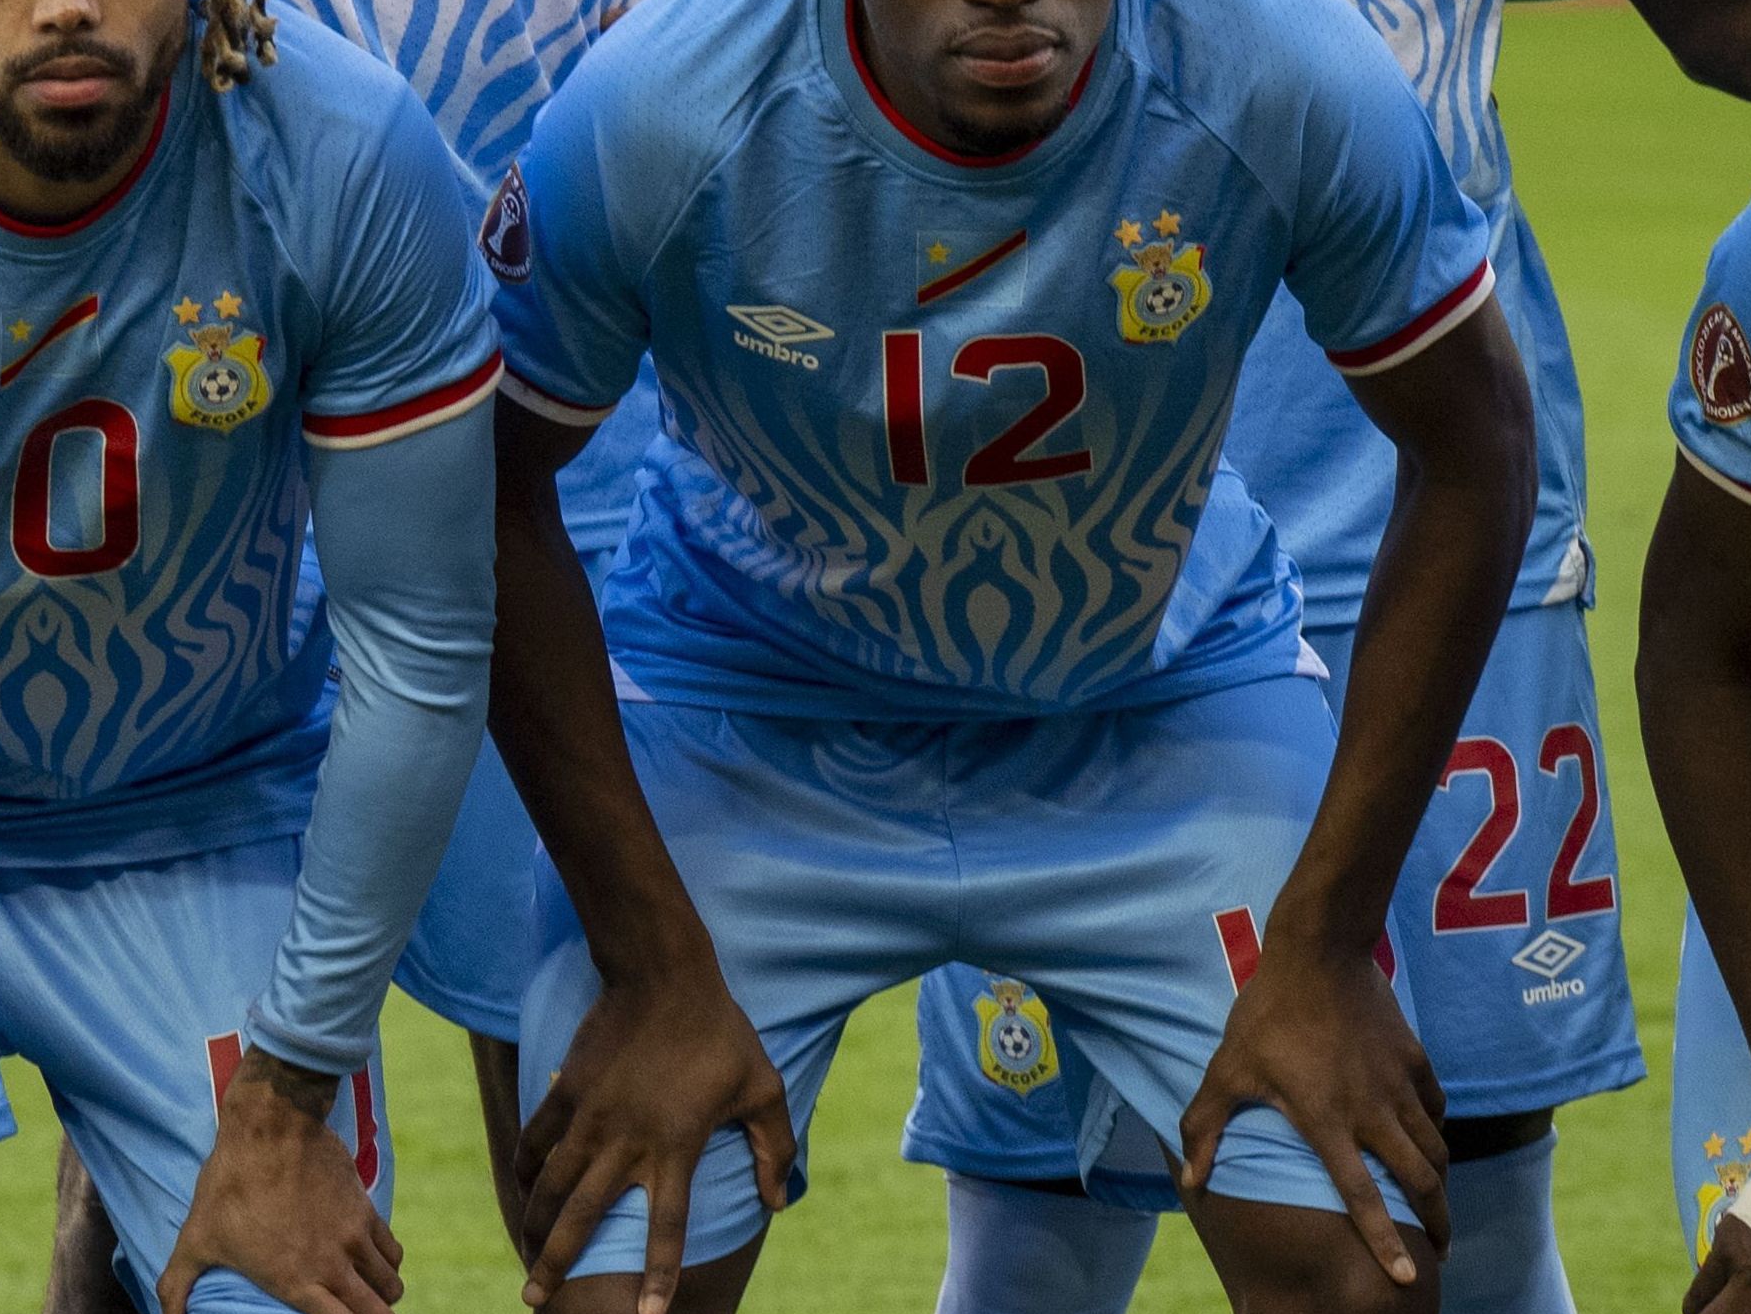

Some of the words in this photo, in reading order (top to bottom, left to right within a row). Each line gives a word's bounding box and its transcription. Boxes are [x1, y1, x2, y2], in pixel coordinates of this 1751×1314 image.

[1139, 304, 1199, 337] FECOFA
[733, 330, 819, 370] umbro
[882, 328, 1095, 487] 12
[1429, 722, 1617, 937] 22
[1523, 978, 1584, 1005] umbro
[992, 1063, 1048, 1084] FECOFA
